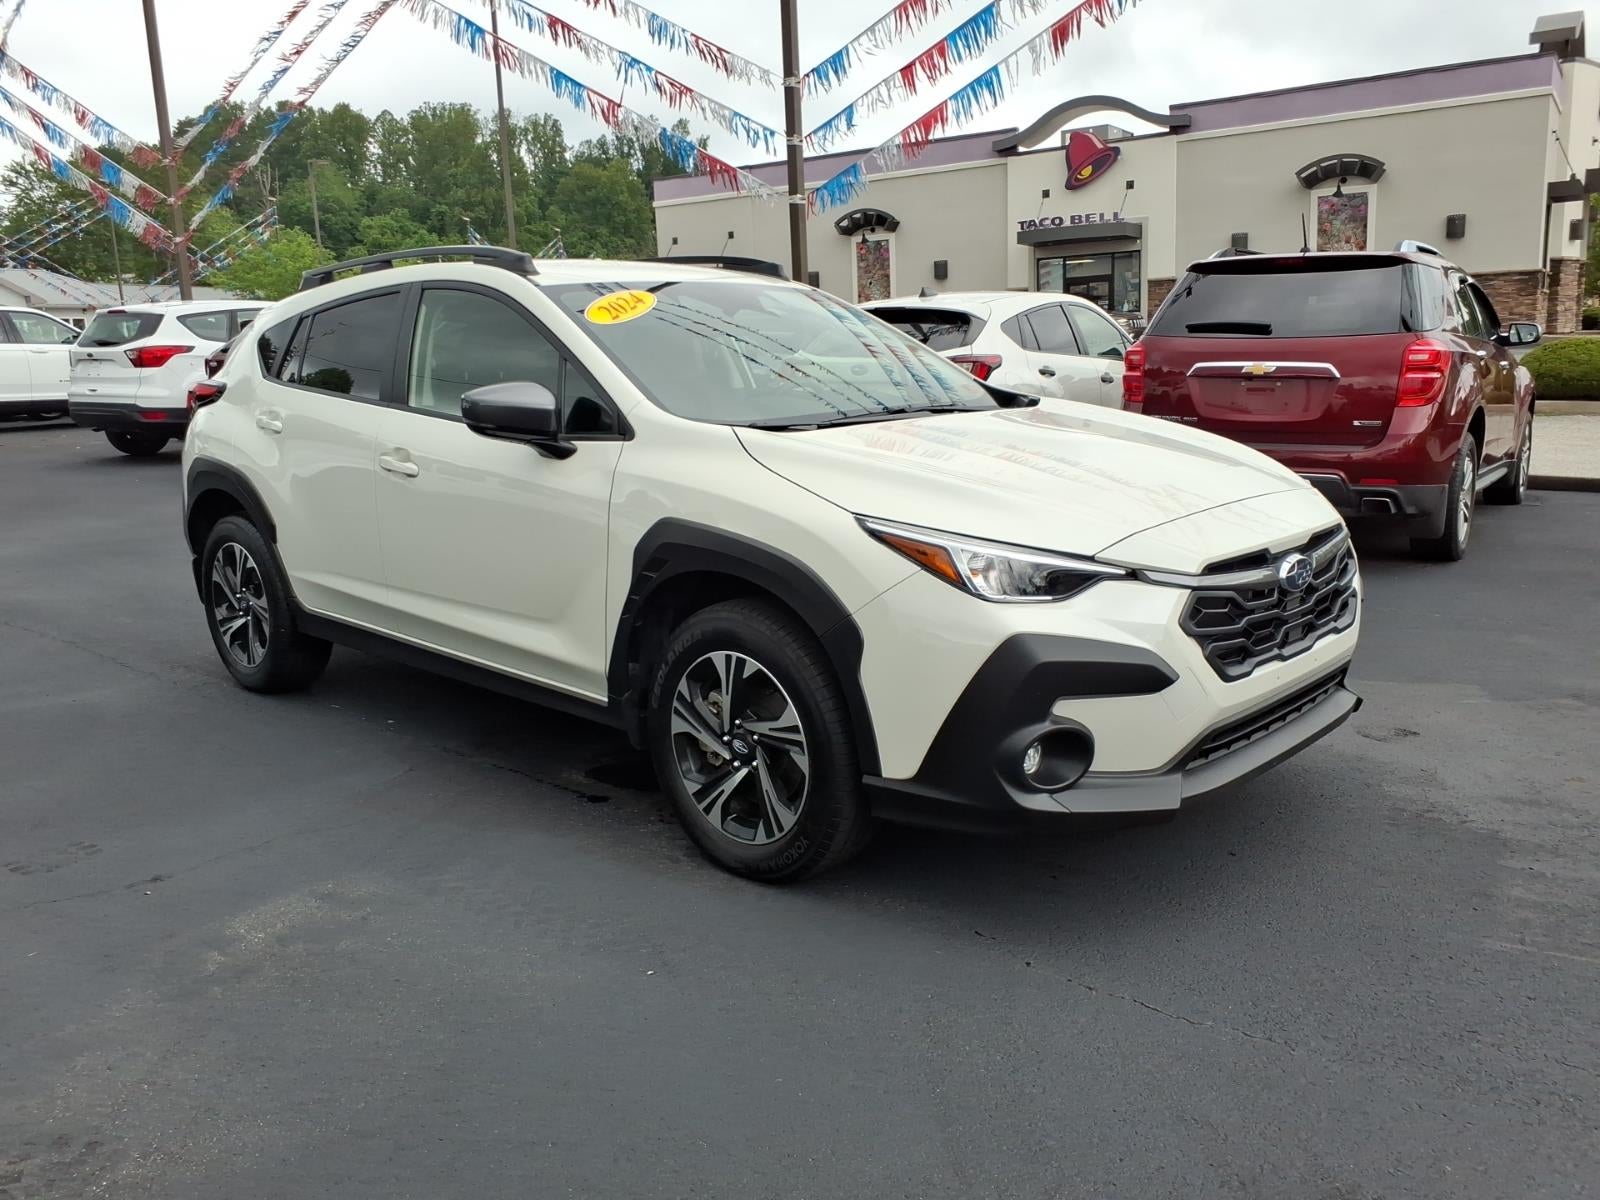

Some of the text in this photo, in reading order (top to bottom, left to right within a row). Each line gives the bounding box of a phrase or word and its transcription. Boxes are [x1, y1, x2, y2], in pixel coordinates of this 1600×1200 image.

[1017, 212, 1125, 231] TACO BELL
[597, 292, 646, 320] 2024
